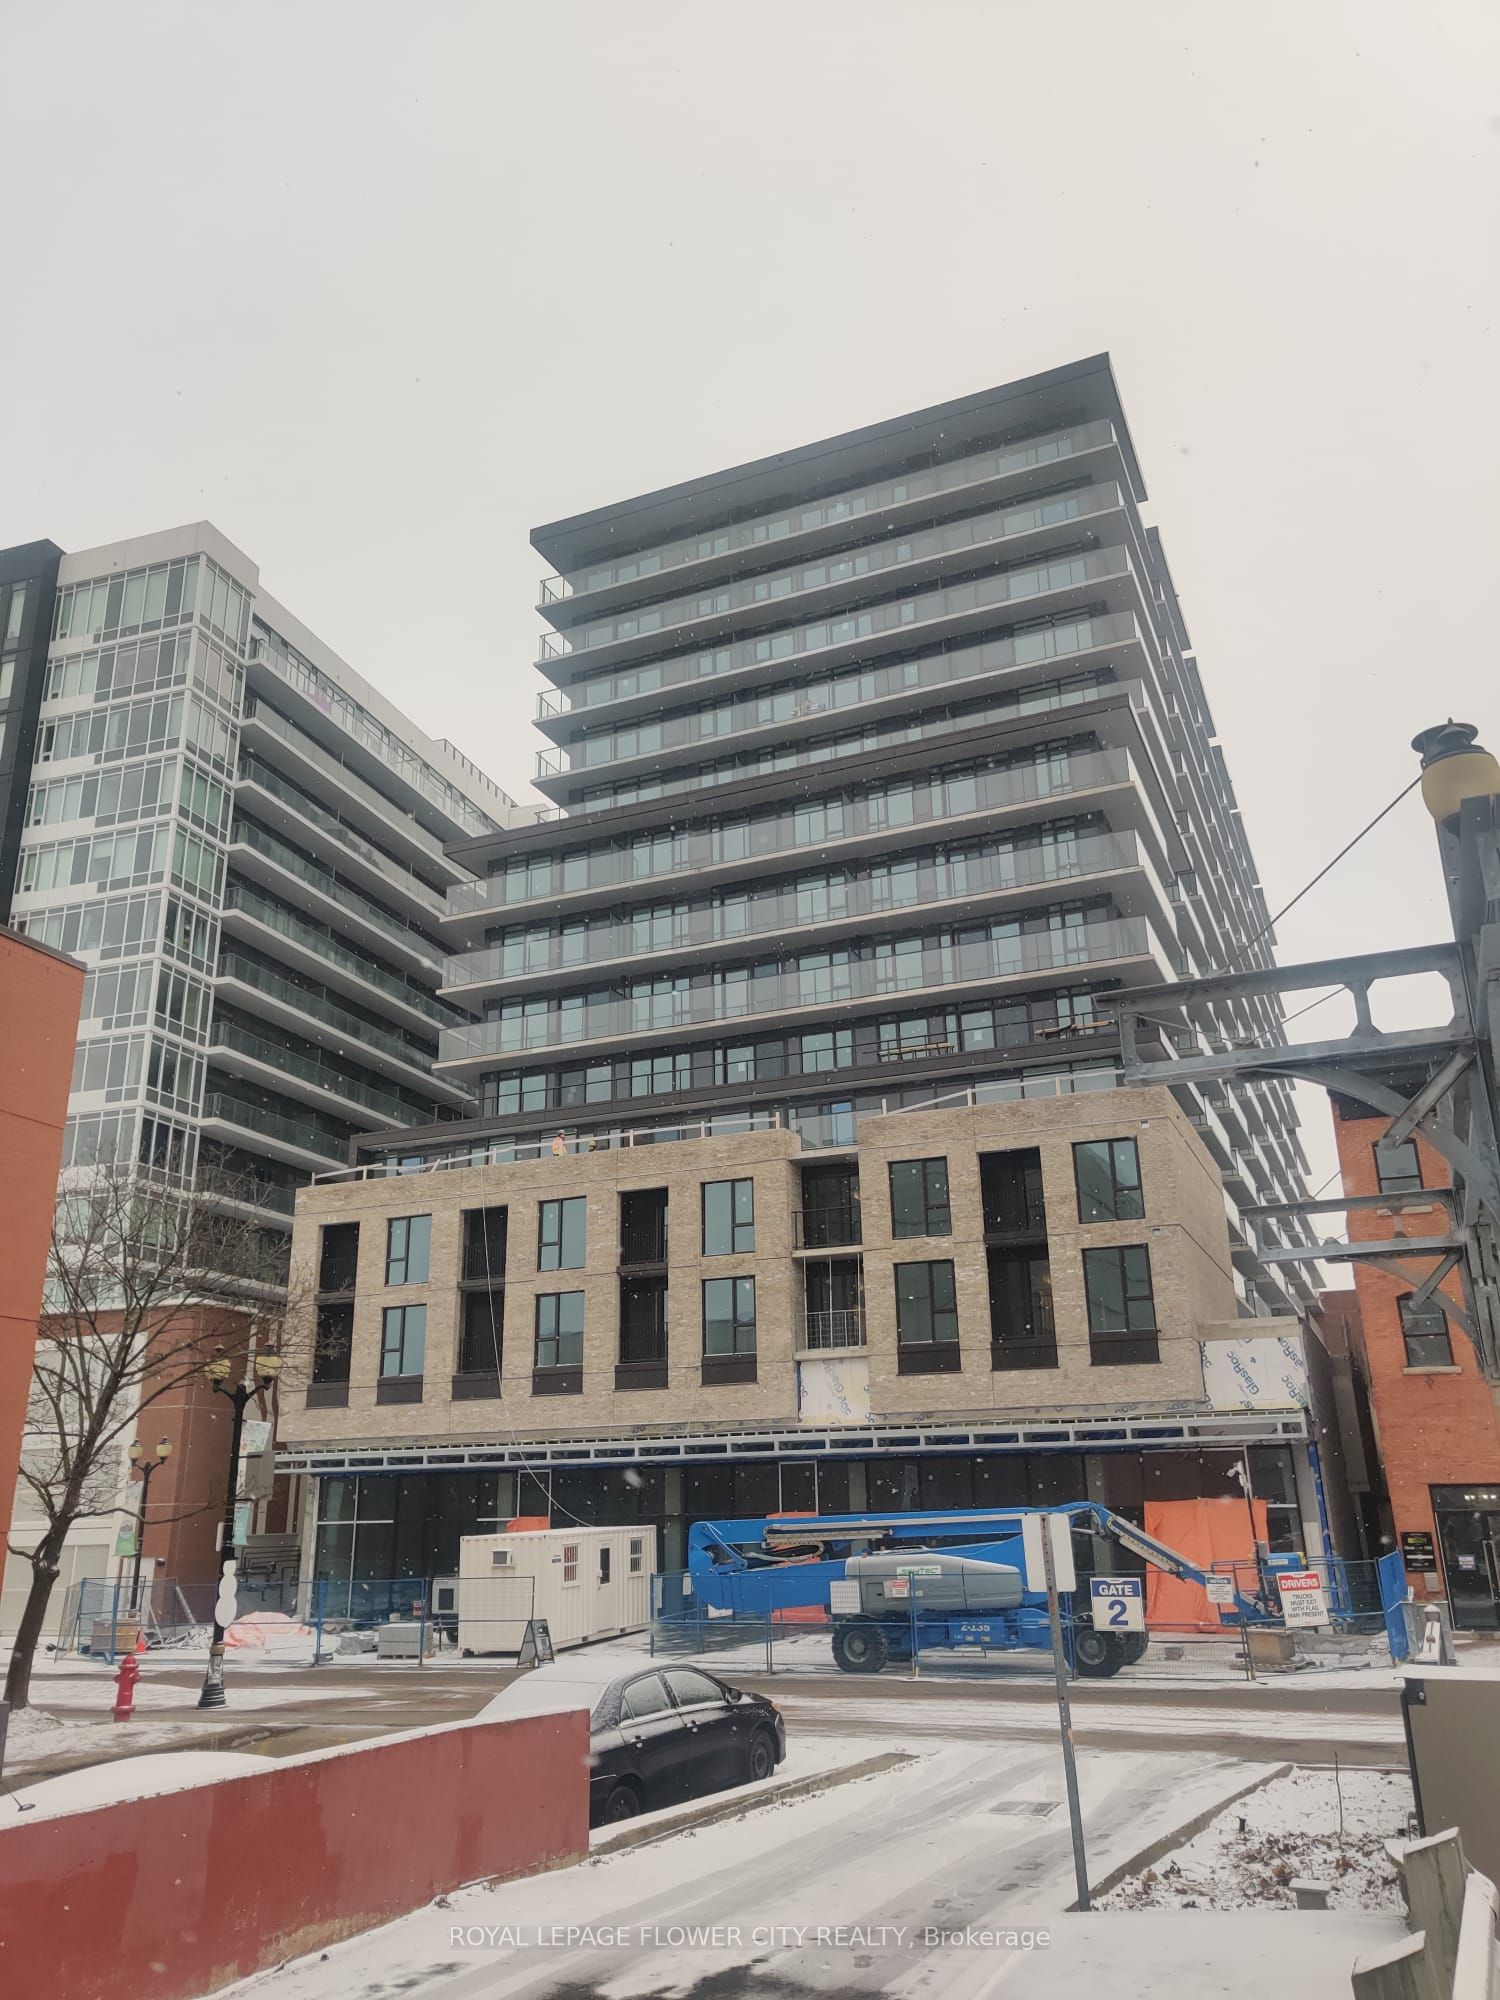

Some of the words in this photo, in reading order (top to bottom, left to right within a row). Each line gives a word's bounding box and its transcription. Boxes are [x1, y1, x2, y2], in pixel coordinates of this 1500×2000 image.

[1226, 1351, 1260, 1396] GlasRoc
[1098, 1584, 1134, 1596] GATE
[1280, 1578, 1319, 1589] DRIVERS
[1108, 1599, 1129, 1626] 2
